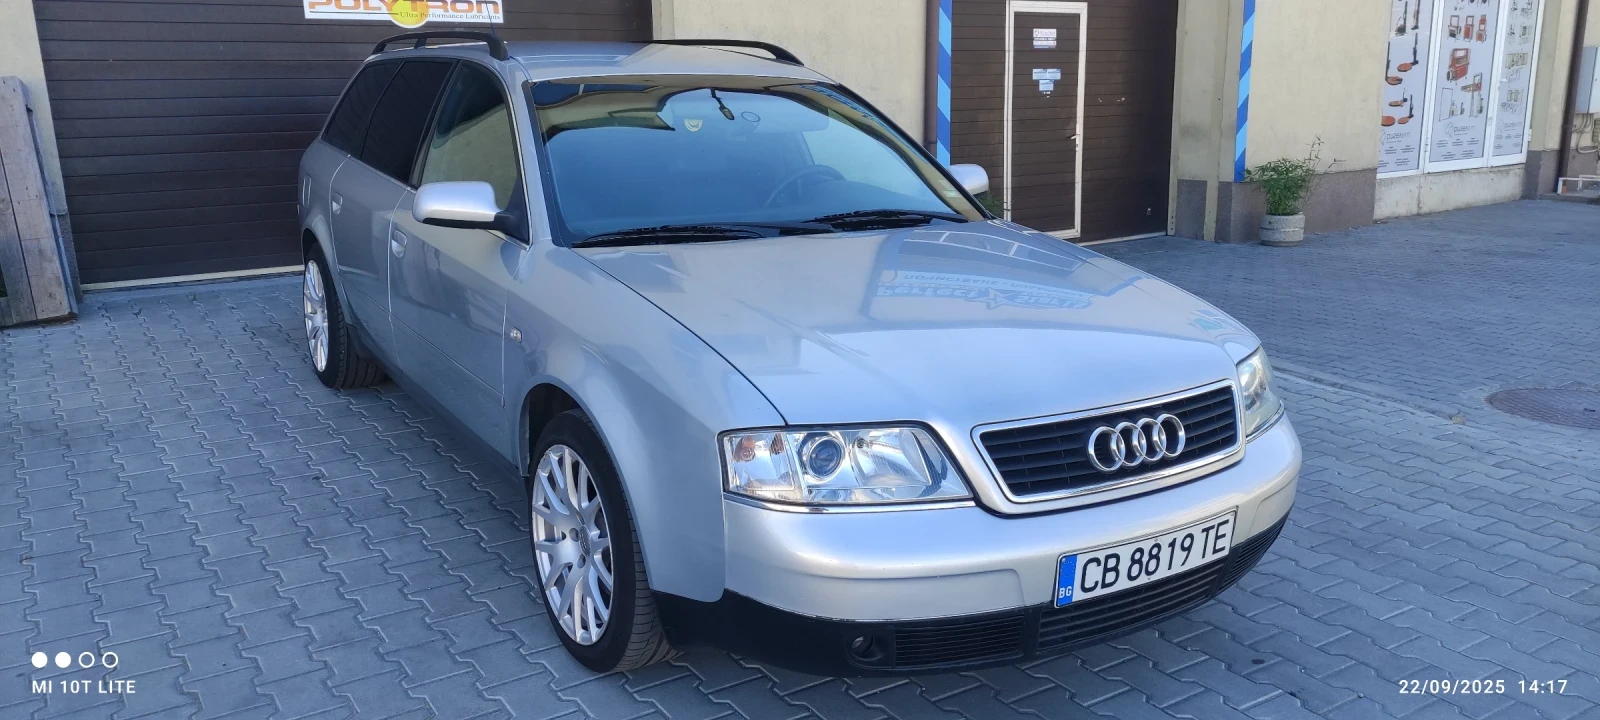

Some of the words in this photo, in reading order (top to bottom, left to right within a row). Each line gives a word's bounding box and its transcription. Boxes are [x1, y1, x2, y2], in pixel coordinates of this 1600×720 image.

[1080, 552, 1121, 593] CB
[1126, 532, 1195, 582] 8819
[1200, 519, 1230, 559] TE
[1059, 585, 1072, 599] BG
